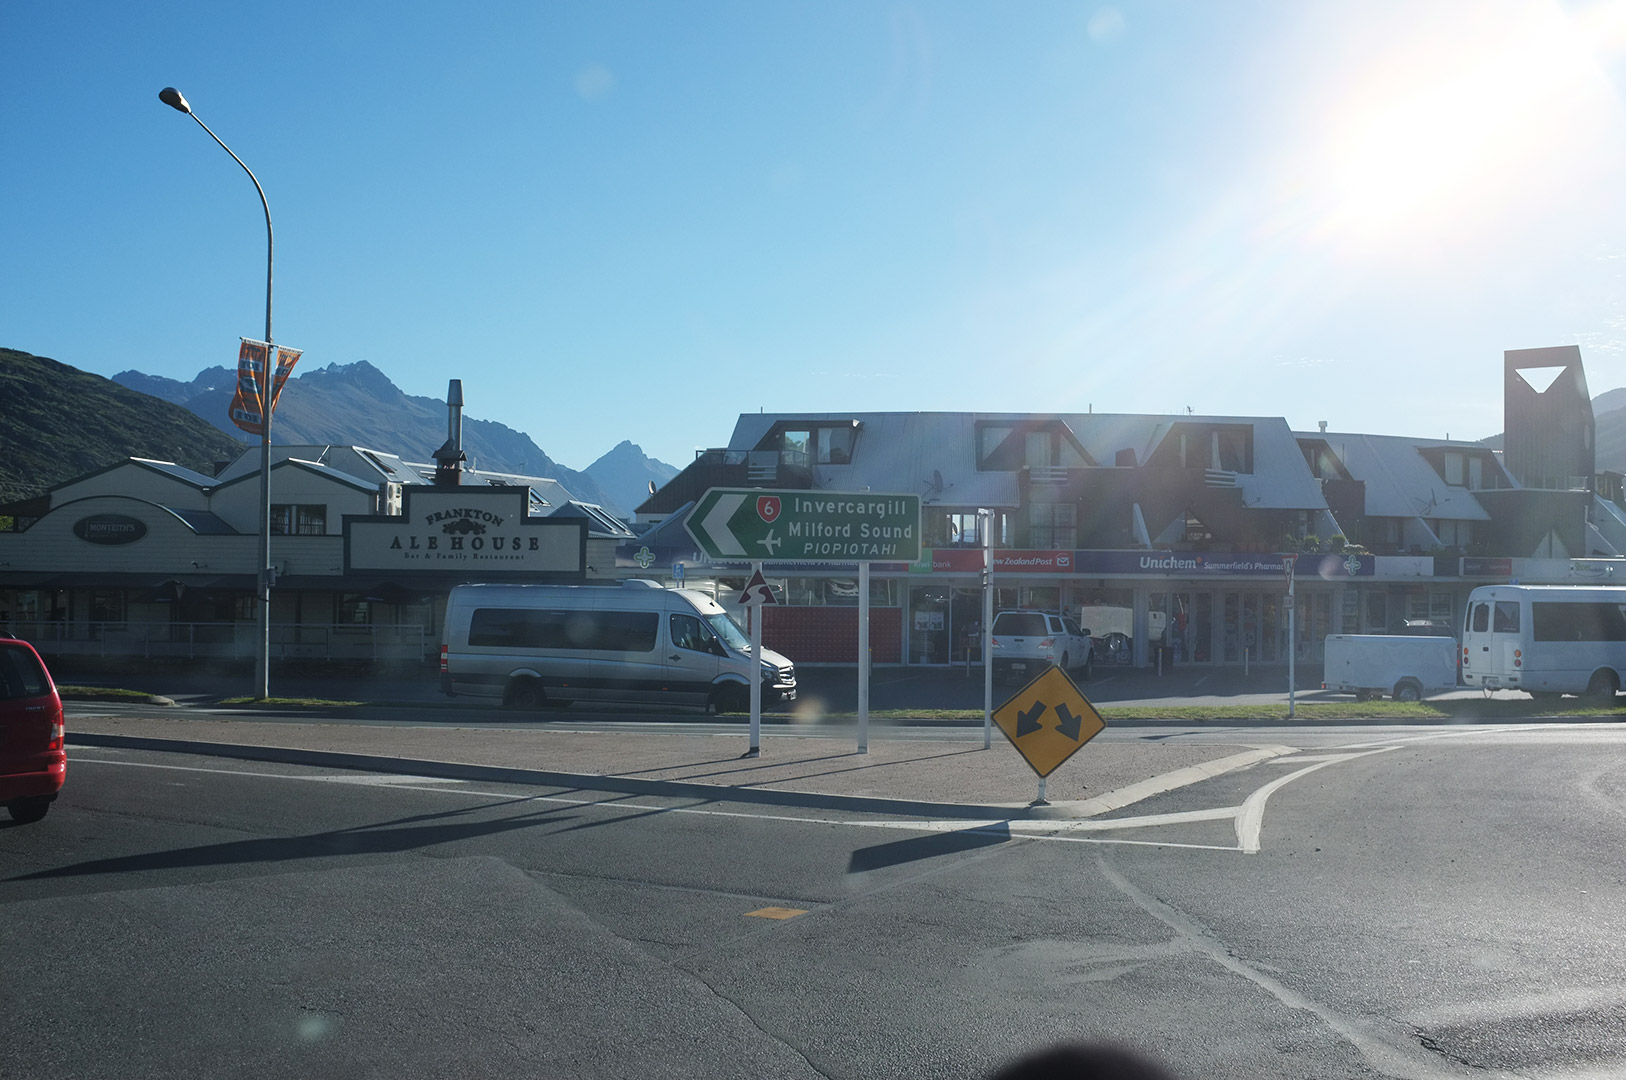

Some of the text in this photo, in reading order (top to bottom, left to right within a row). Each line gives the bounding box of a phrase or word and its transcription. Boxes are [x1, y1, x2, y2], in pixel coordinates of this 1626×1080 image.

[763, 500, 774, 516] 6
[795, 498, 906, 519] Invercargill
[425, 508, 504, 527] FRANKTON
[89, 524, 135, 532] MONTEITH'S
[789, 521, 912, 539] Milford Sound
[390, 536, 539, 551] ALE HOUSE
[803, 543, 897, 556] PIOPIOTAHI
[436, 552, 468, 561] Family
[1139, 556, 1197, 569] Unichem
[1204, 561, 1284, 570] Summerfield's Pharmac
